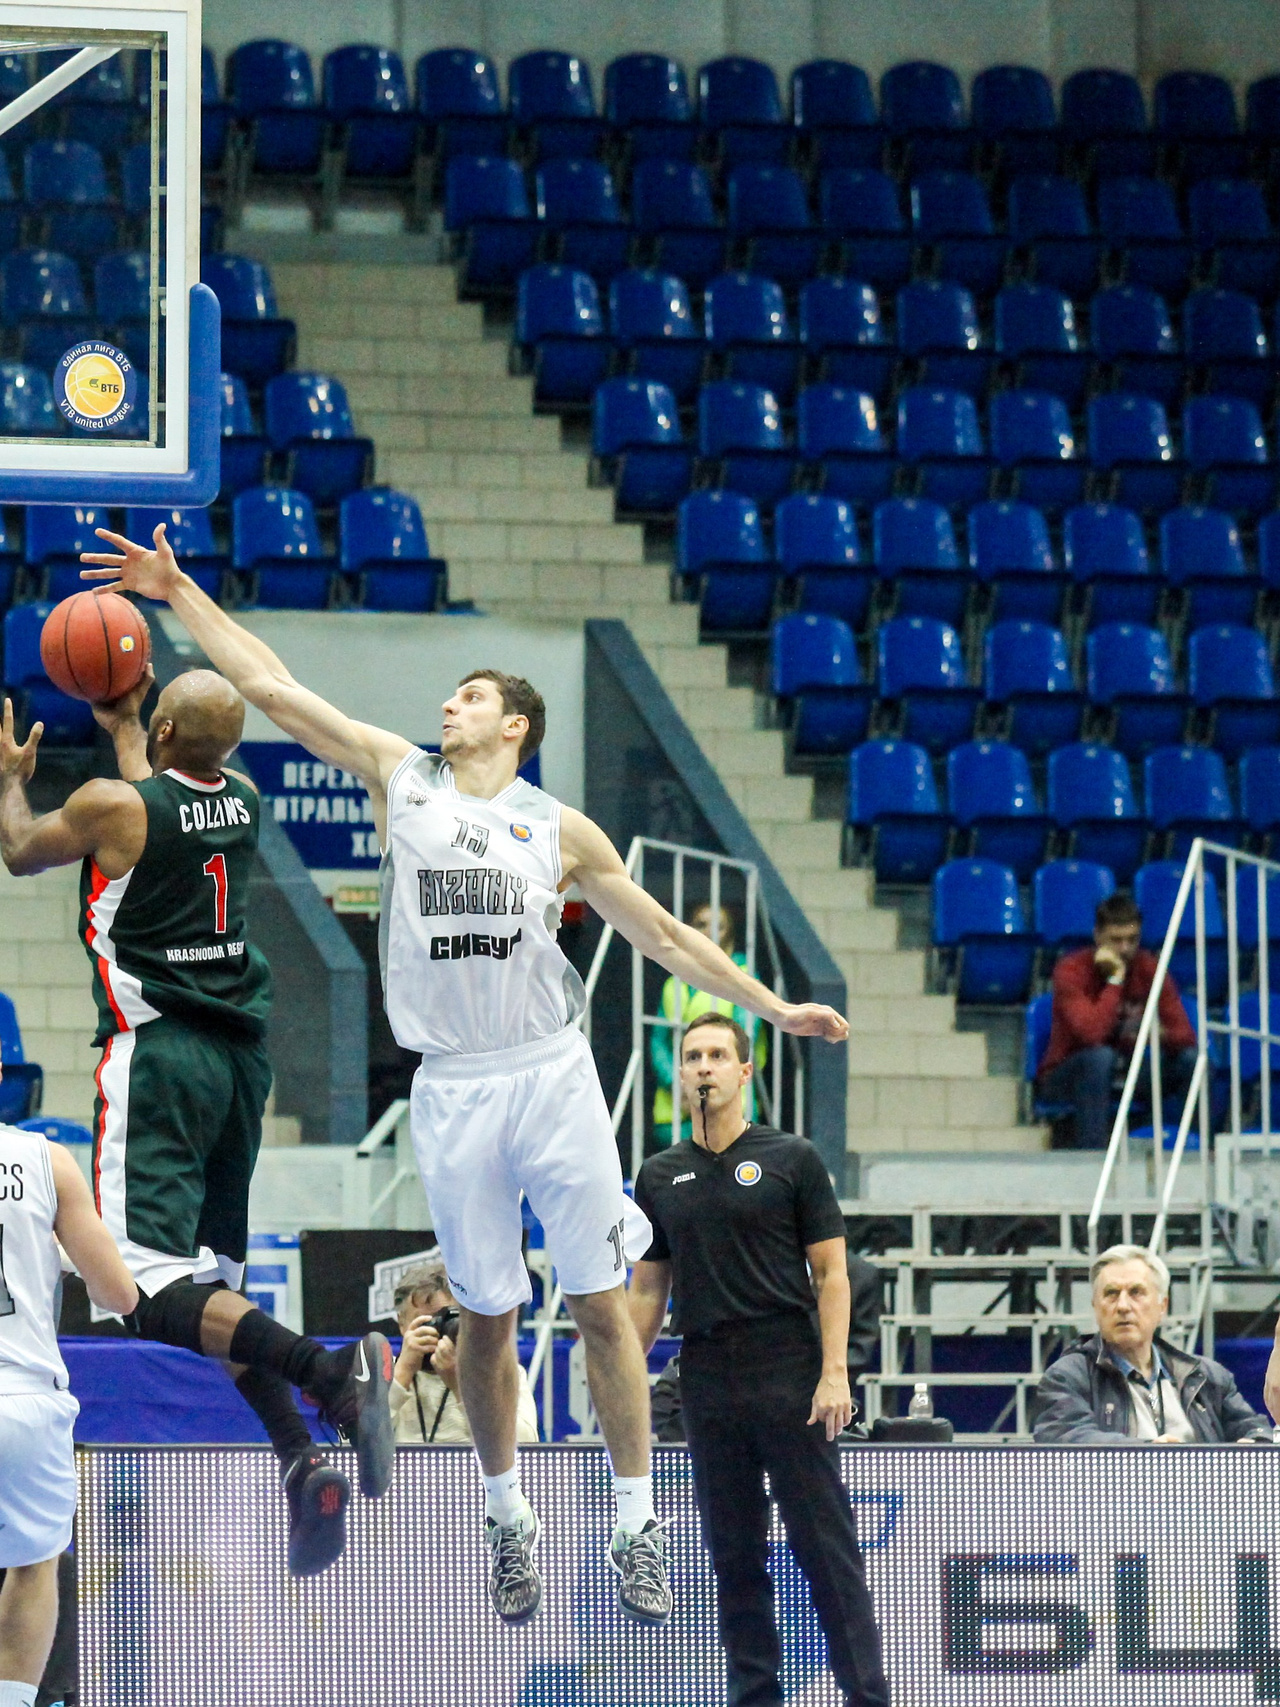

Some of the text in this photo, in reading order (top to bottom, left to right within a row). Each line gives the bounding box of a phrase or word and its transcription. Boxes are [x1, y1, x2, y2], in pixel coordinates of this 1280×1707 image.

[62, 344, 132, 372] единая лига ВТБ
[100, 383, 120, 394] ВТБ
[60, 399, 131, 429] VTB united league
[283, 761, 366, 789] ПЕРЕХ
[451, 816, 490, 859] 13
[202, 853, 228, 934] 1
[166, 944, 225, 962] KRASNODAR
